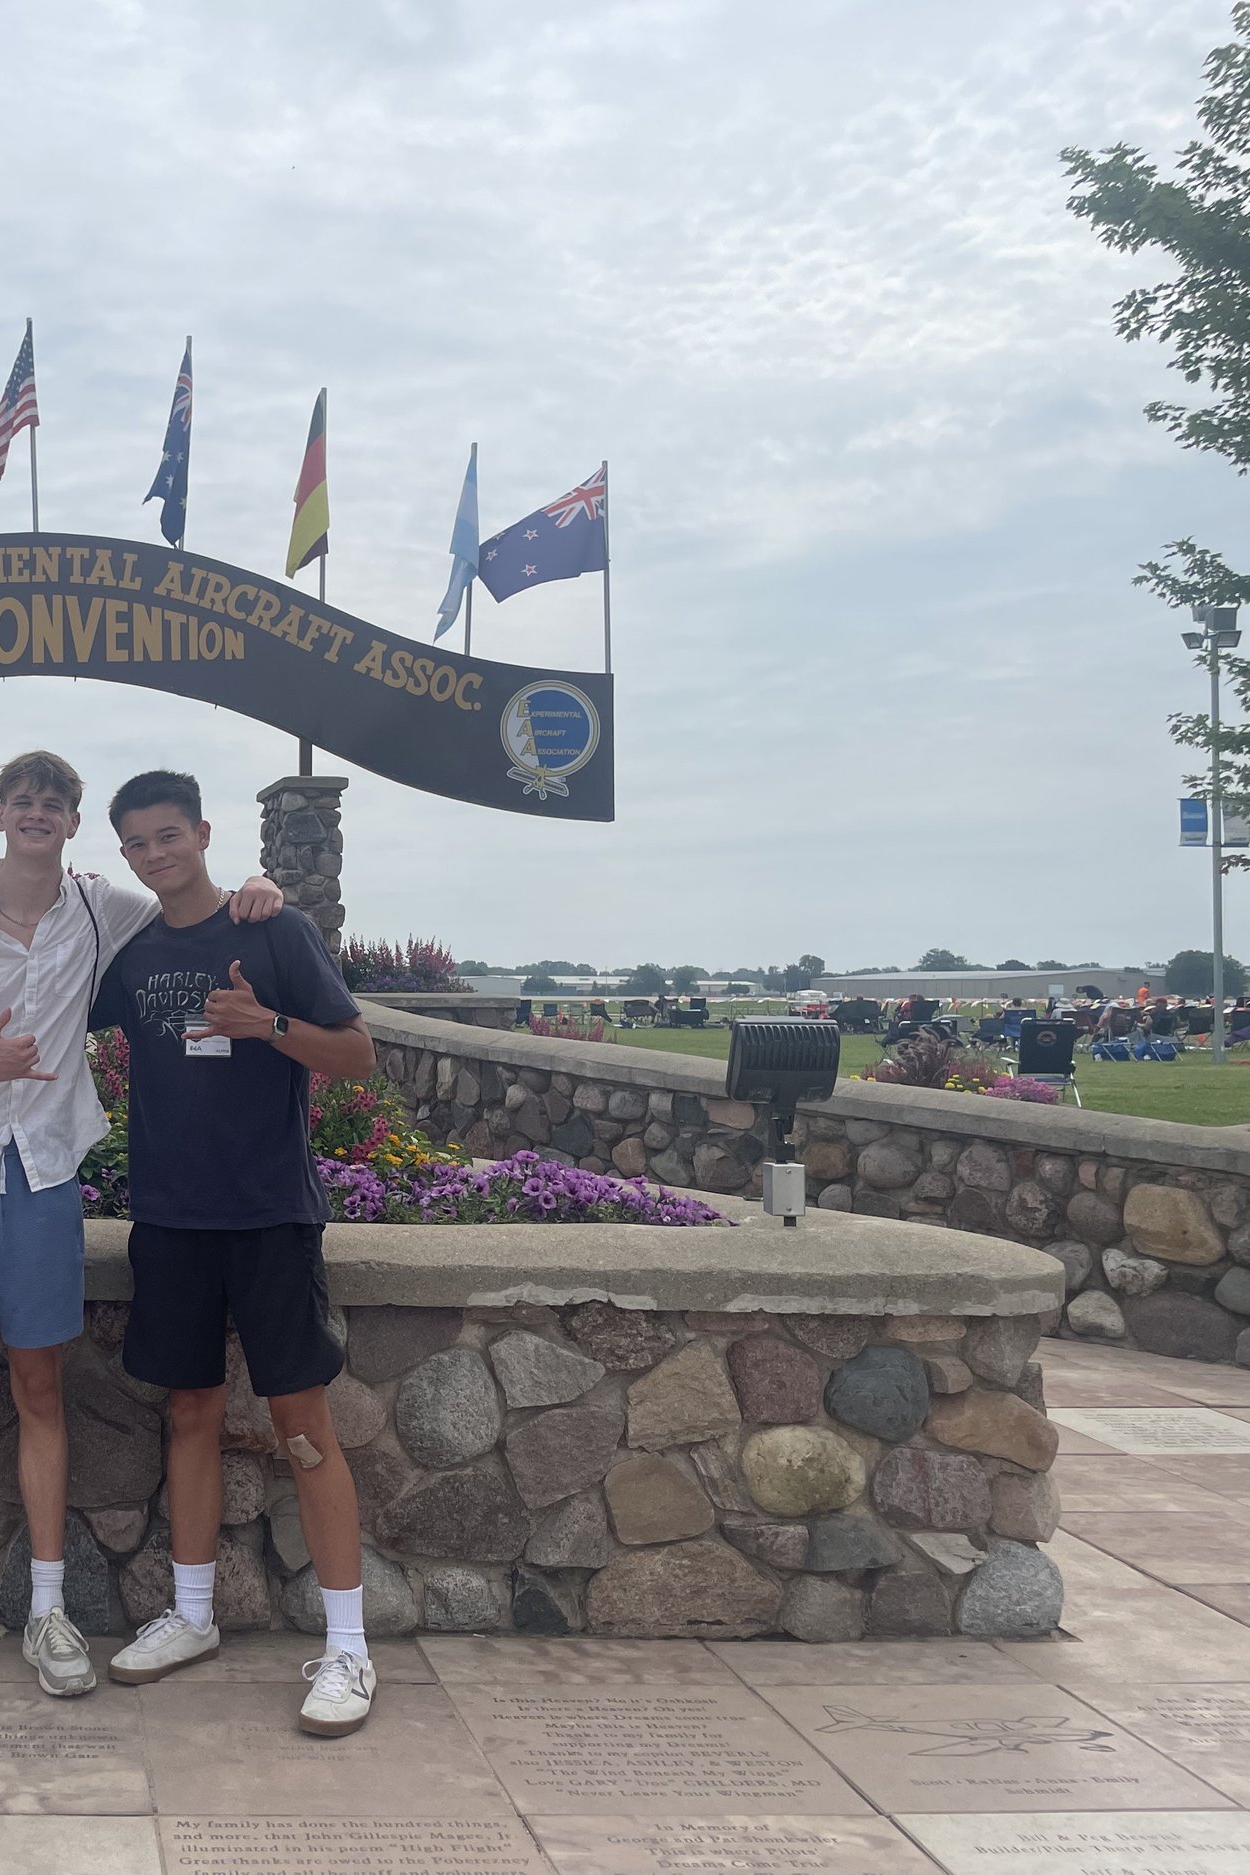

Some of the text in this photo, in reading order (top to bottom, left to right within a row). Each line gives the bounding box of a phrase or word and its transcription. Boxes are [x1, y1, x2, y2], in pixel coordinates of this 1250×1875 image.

[153, 561, 354, 664] AIRCRAFT
[353, 640, 484, 711] ASSOC.
[176, 1821, 200, 1829] My
[208, 1821, 259, 1829] family
[266, 1821, 292, 1829] has
[299, 1821, 336, 1829] done
[342, 1821, 367, 1829] the
[373, 1821, 442, 1829] hundred
[681, 1824, 749, 1833] Memory
[754, 1824, 770, 1833] of
[174, 1833, 202, 1841] and
[264, 1833, 297, 1841] that
[304, 1833, 343, 1841] John
[350, 1833, 423, 1841] Gillespie
[608, 1836, 668, 1844] George
[709, 1836, 737, 1844] Pat
[181, 1845, 279, 1853] illuminated
[286, 1845, 302, 1853] in
[308, 1845, 333, 1853] his
[339, 1845, 383, 1853] poem
[645, 1848, 686, 1856] This
[179, 1857, 226, 1866] Great
[233, 1857, 290, 1866] thanks
[296, 1857, 322, 1866] are
[329, 1857, 370, 1866] owed
[376, 1857, 392, 1866] to
[398, 1857, 424, 1866] the
